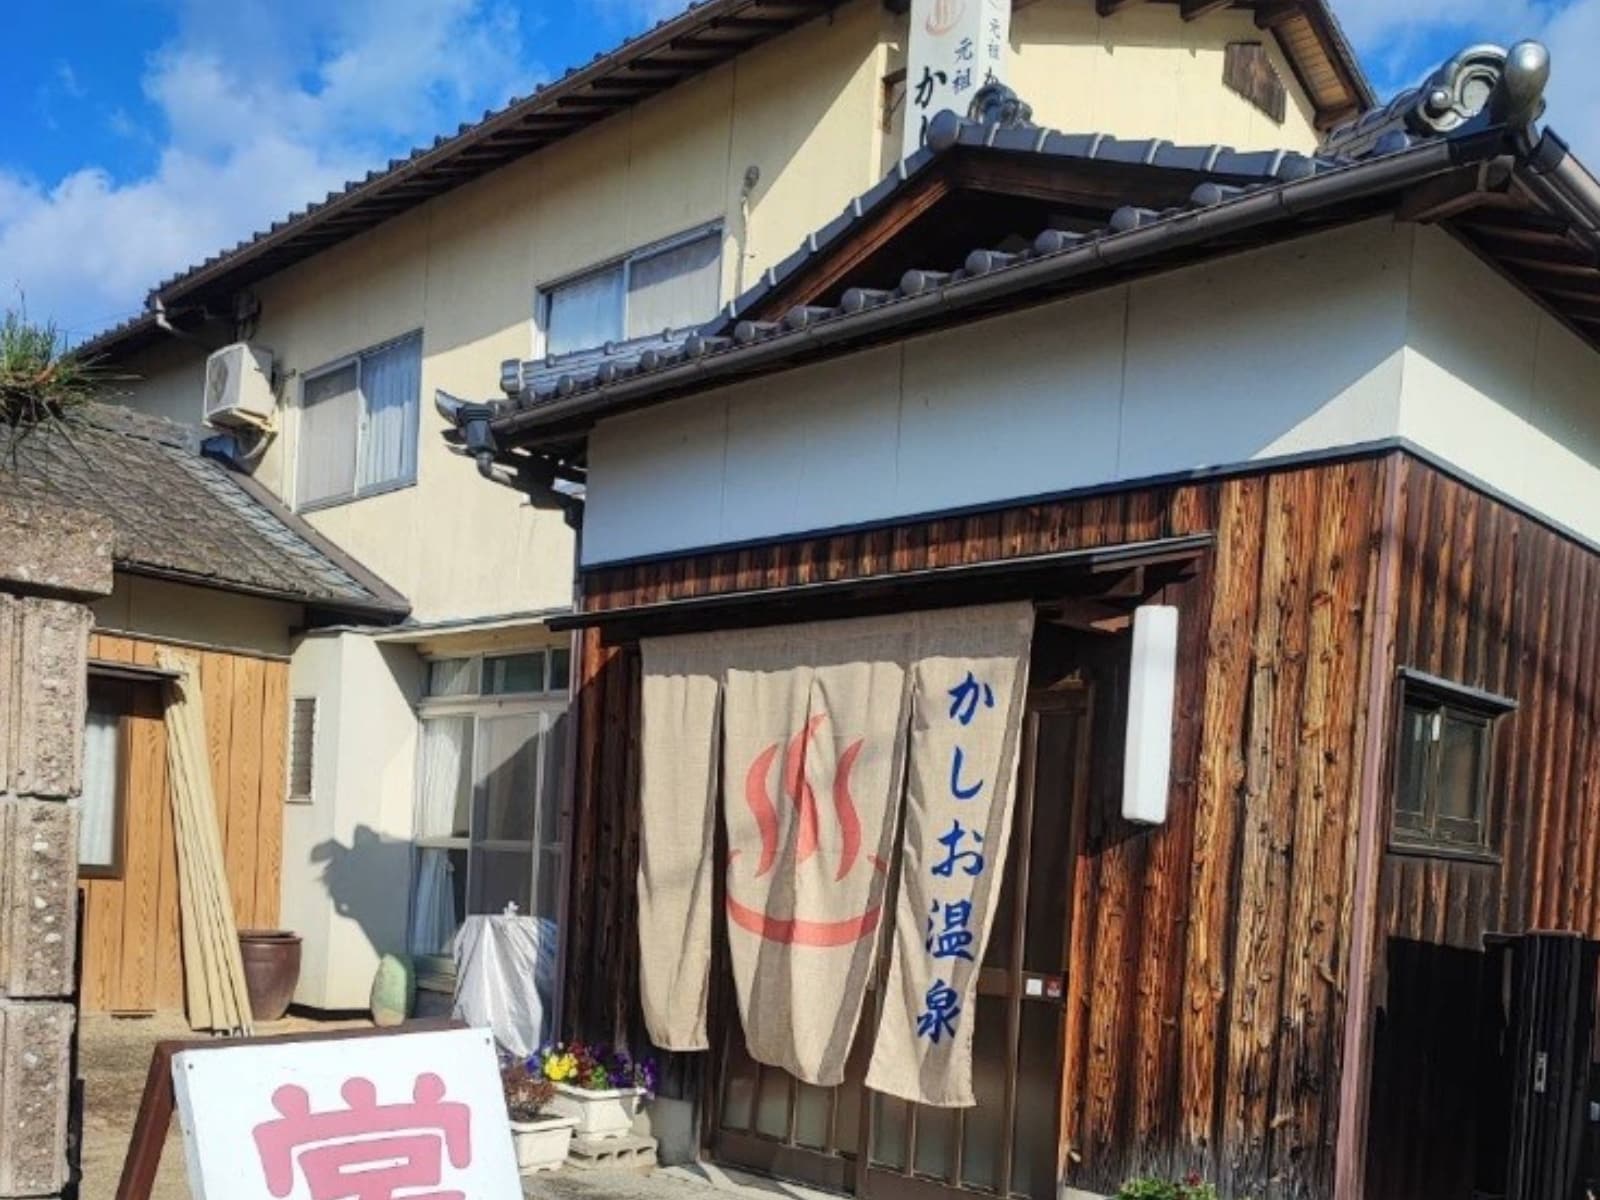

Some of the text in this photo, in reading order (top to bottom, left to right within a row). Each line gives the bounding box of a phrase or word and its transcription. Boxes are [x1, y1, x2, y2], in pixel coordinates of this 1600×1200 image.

[952, 37, 973, 95] 元祖
[916, 671, 994, 1045] かしお温泉
